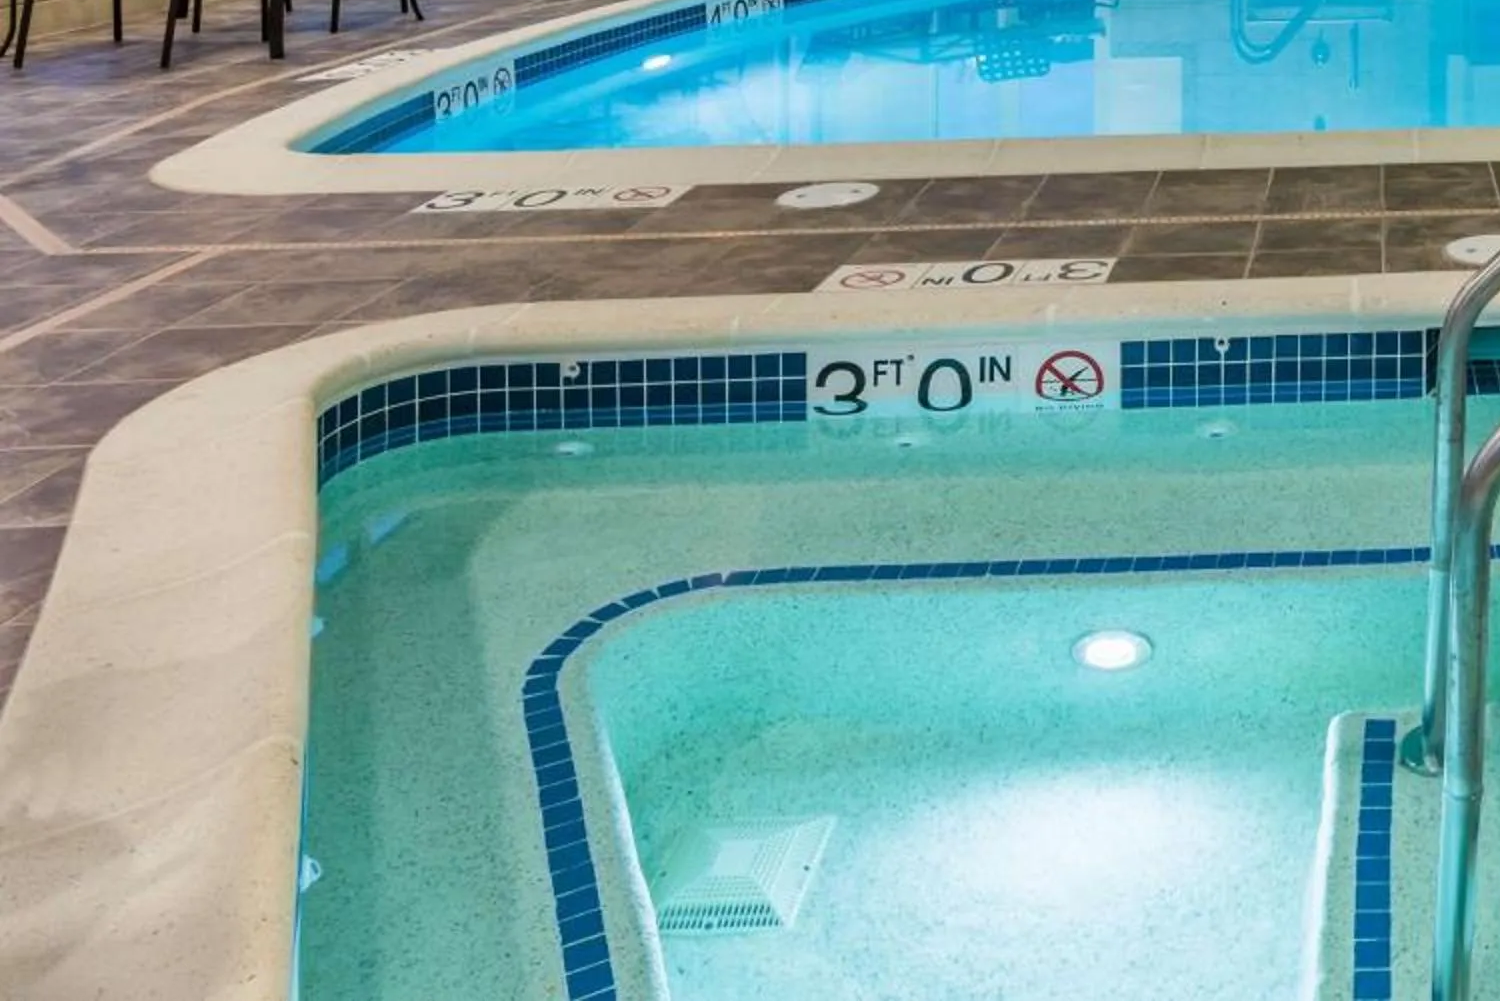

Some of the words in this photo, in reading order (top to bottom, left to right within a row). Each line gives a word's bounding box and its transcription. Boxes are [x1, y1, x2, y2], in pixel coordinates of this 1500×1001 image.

[812, 360, 868, 416] 3
[872, 359, 905, 387] FT
[916, 357, 973, 411] 0
[978, 355, 1012, 384] IN
